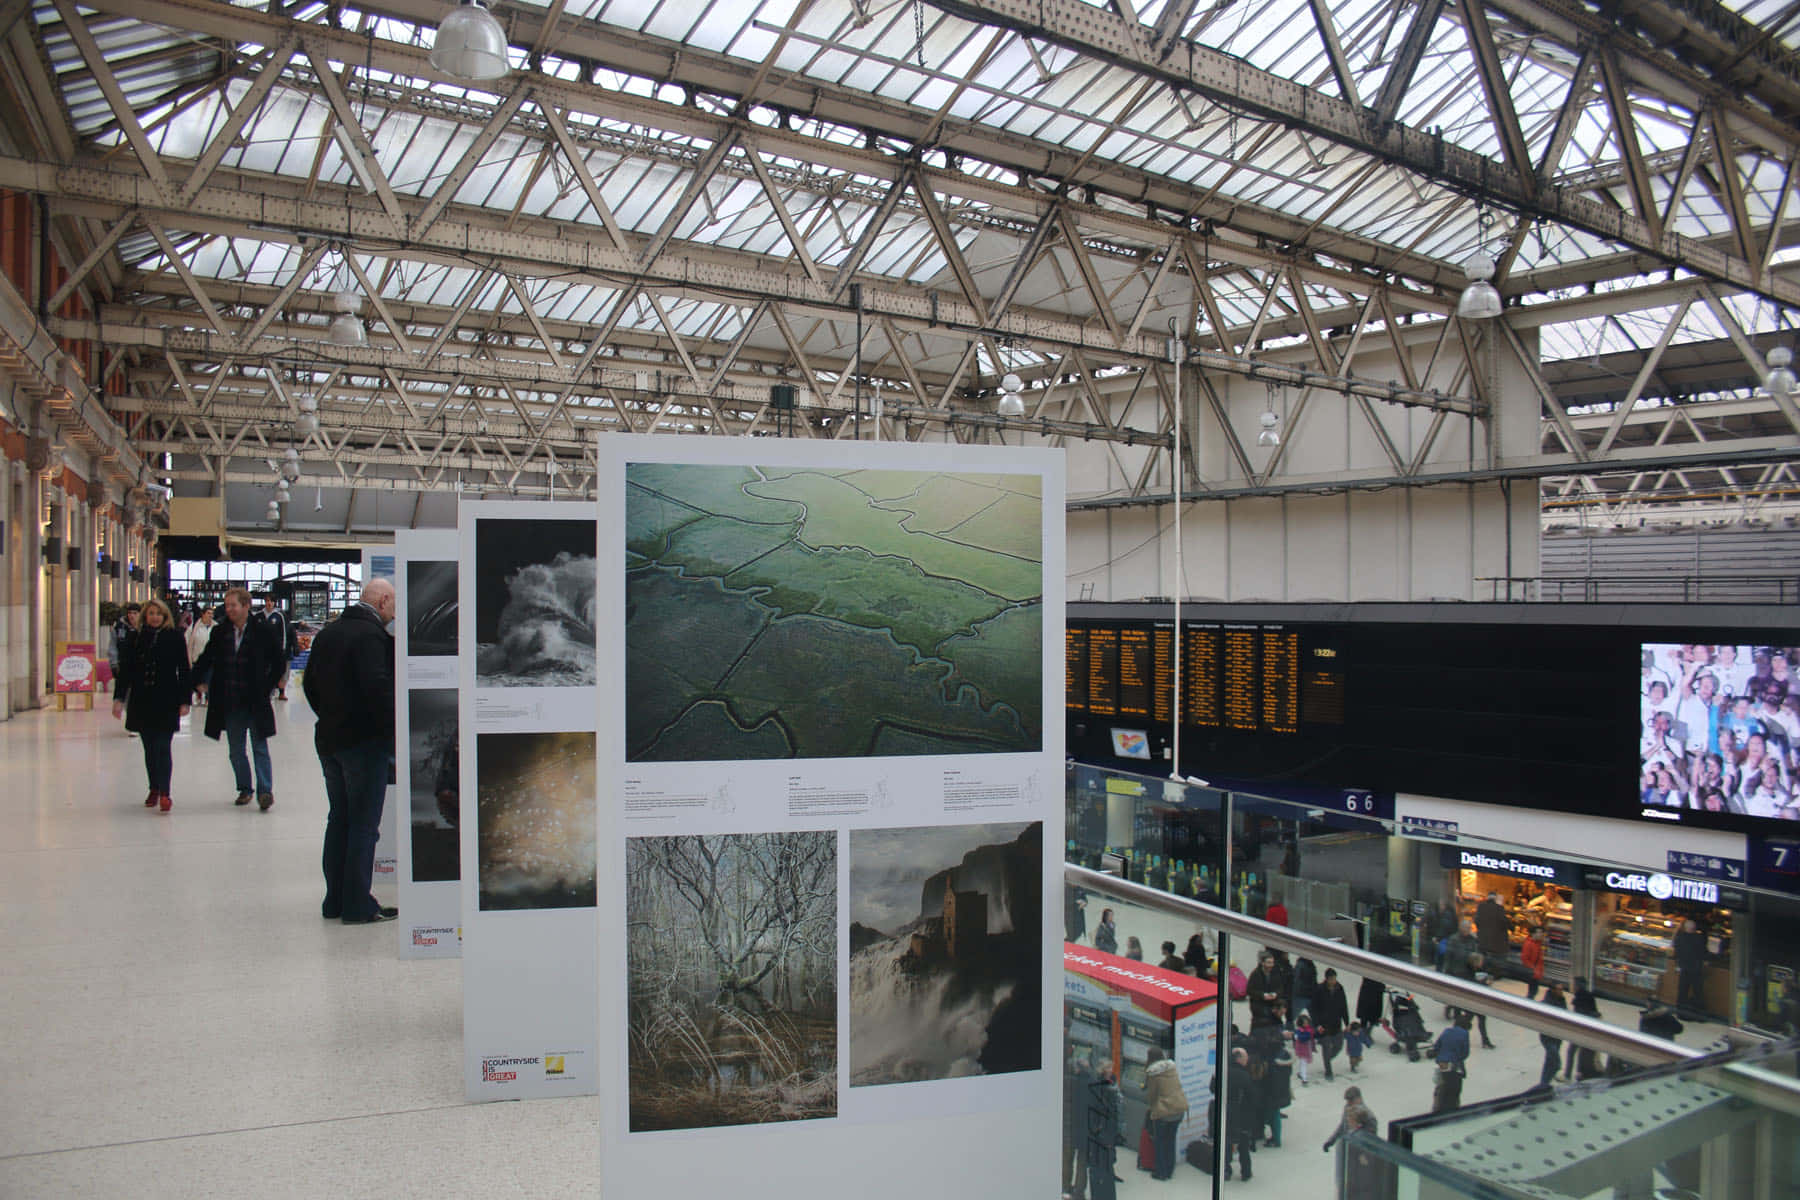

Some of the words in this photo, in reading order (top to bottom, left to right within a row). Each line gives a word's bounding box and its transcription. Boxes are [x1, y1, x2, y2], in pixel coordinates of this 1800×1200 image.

[1346, 795, 1357, 811] 6
[1364, 795, 1374, 811] 6
[1460, 851, 1499, 870] Delice
[1498, 859, 1510, 869] de
[1509, 859, 1555, 878] France
[1771, 847, 1788, 867] 7
[1064, 951, 1104, 968] icket
[1102, 964, 1195, 997] machines
[1064, 977, 1086, 995] kets
[487, 1057, 540, 1066] COUNTRYSIDE
[488, 1072, 516, 1080] GREAT
